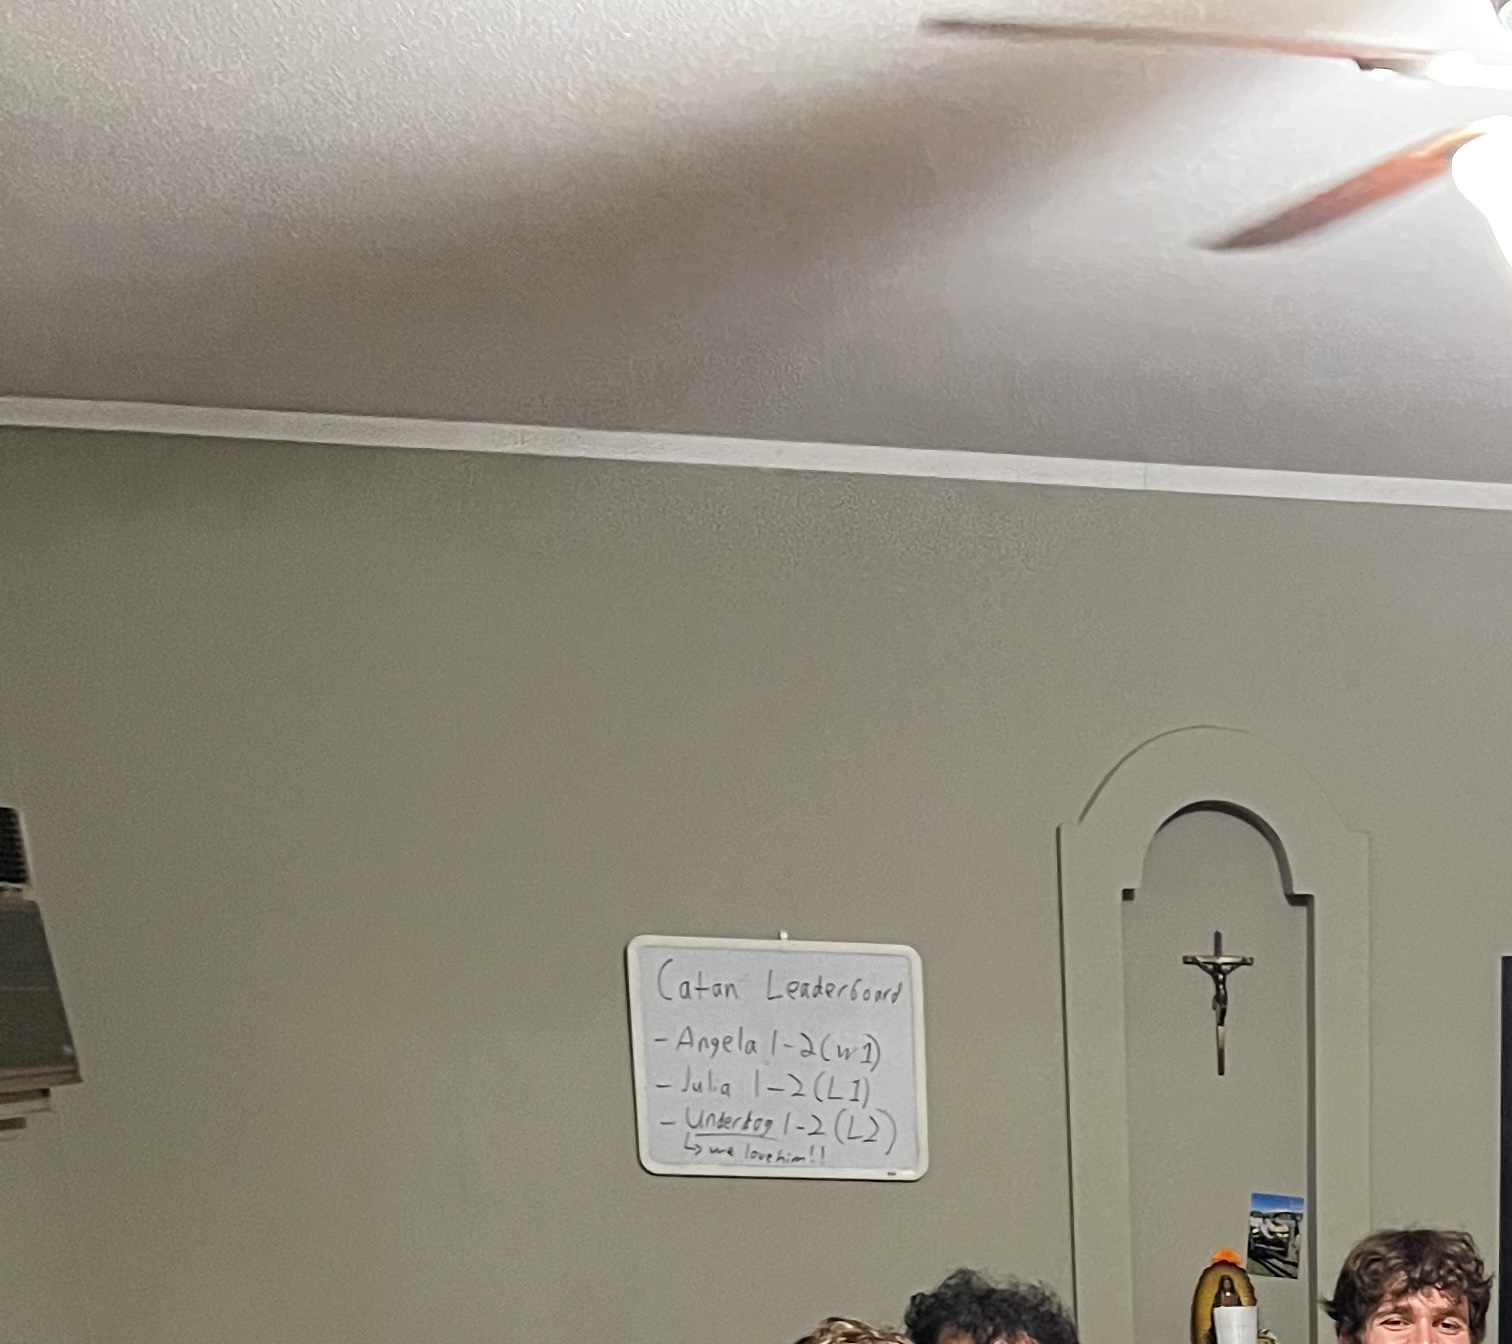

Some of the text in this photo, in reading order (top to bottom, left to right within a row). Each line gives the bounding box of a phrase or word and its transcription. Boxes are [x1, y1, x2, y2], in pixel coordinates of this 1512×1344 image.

[657, 957, 903, 1004] Catan Leaderboard
[675, 1025, 758, 1059] Angela
[681, 1064, 731, 1098] Julia
